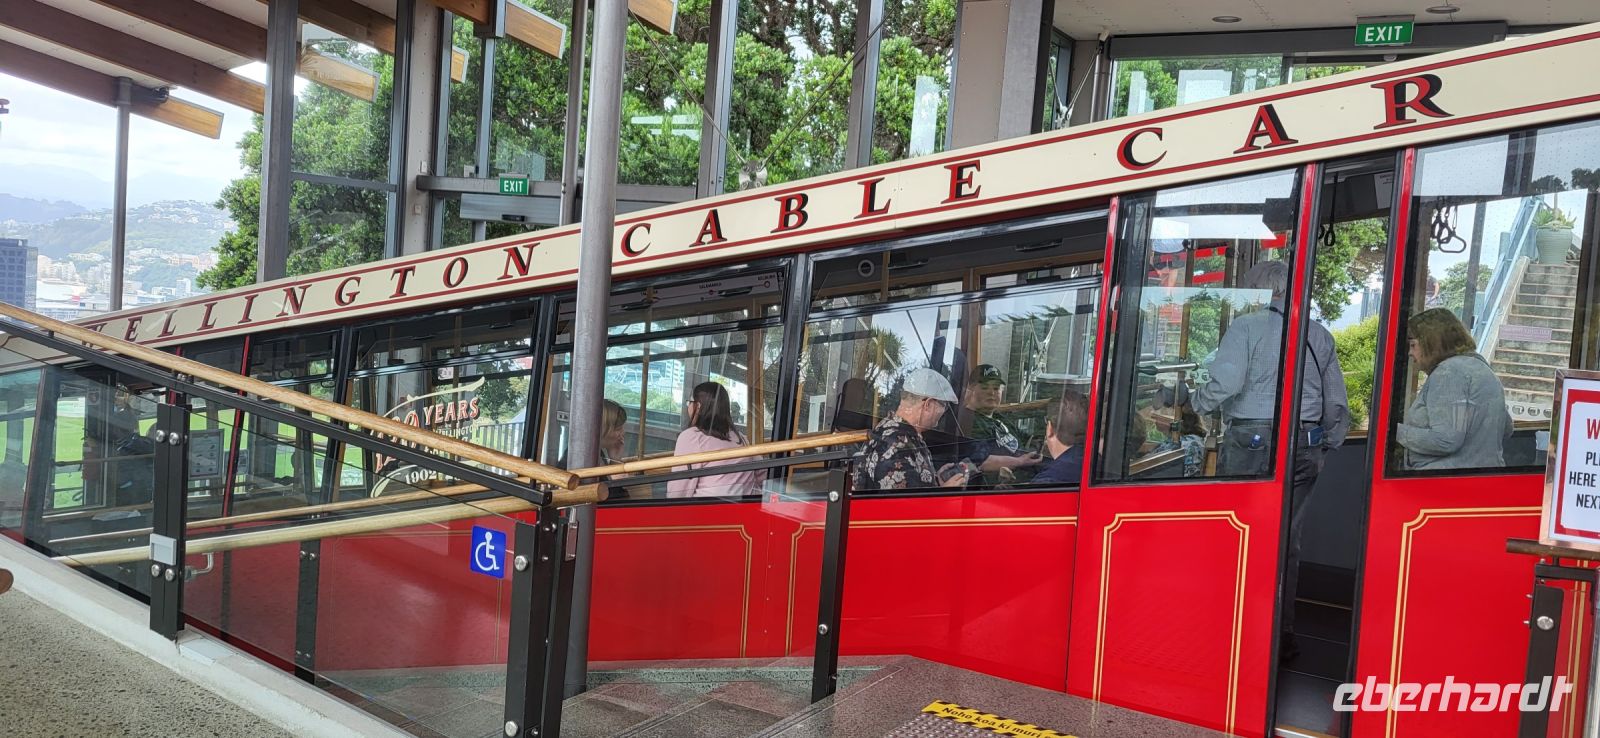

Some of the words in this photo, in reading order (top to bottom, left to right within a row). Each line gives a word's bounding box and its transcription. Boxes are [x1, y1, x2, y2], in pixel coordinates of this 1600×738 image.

[1365, 26, 1403, 42] EXIT
[620, 159, 981, 257] CABLE
[1117, 73, 1455, 171] CAR
[504, 180, 523, 193] EXIT
[423, 397, 480, 426] YEARS
[1585, 451, 1600, 467] PL
[1568, 471, 1597, 488] HERE
[942, 707, 973, 720] Noho
[975, 716, 996, 727] koa
[998, 723, 1011, 731] ki
[1012, 727, 1041, 738] muri
